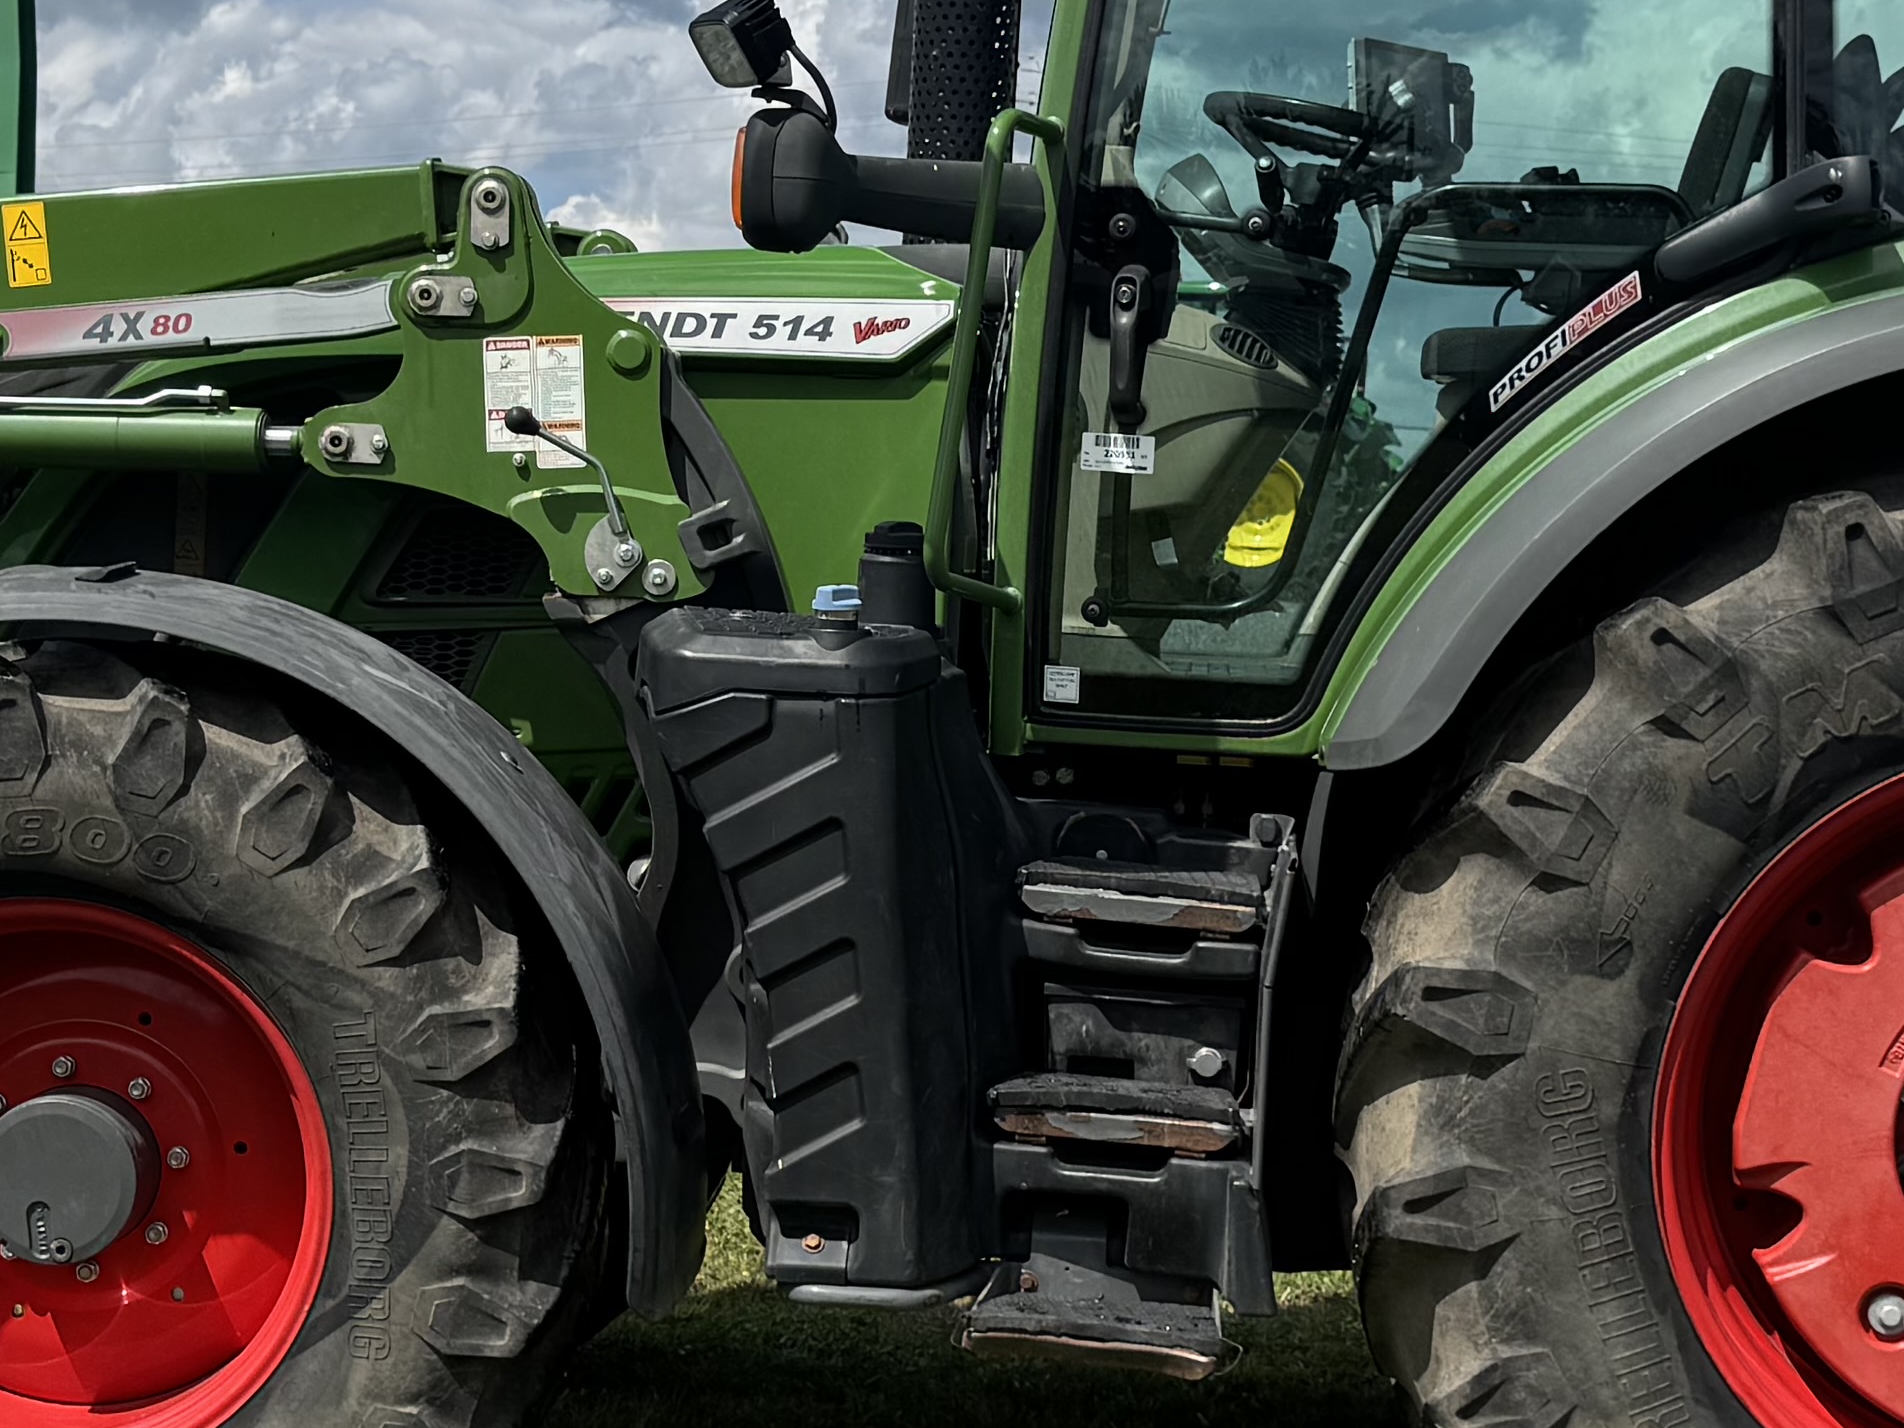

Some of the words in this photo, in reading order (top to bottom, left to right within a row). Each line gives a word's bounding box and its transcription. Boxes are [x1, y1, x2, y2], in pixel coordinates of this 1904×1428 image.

[618, 311, 738, 339] NDT
[749, 315, 836, 341] 514
[332, 1010, 394, 1362] TRELLEBORG
